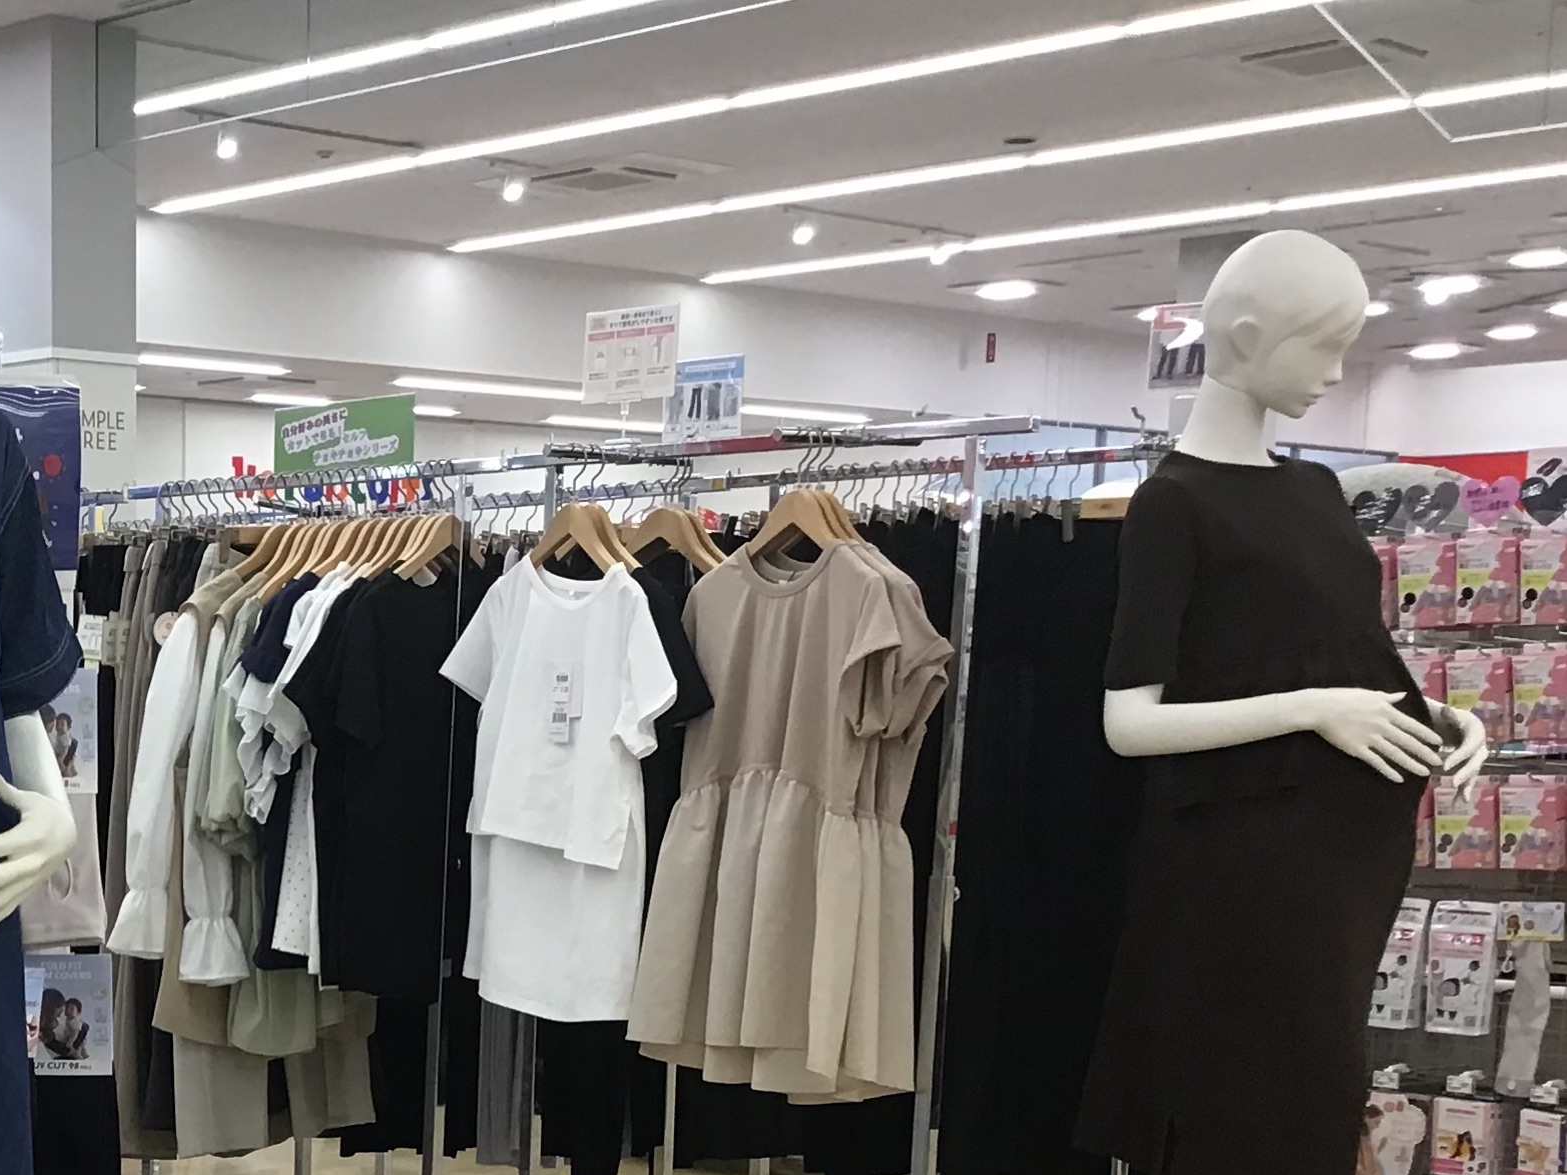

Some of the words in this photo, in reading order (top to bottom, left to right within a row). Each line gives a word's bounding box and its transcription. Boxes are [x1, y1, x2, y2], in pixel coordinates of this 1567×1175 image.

[82, 410, 125, 431] MPLE
[84, 431, 117, 451] REE
[47, 1061, 66, 1070] CUT
